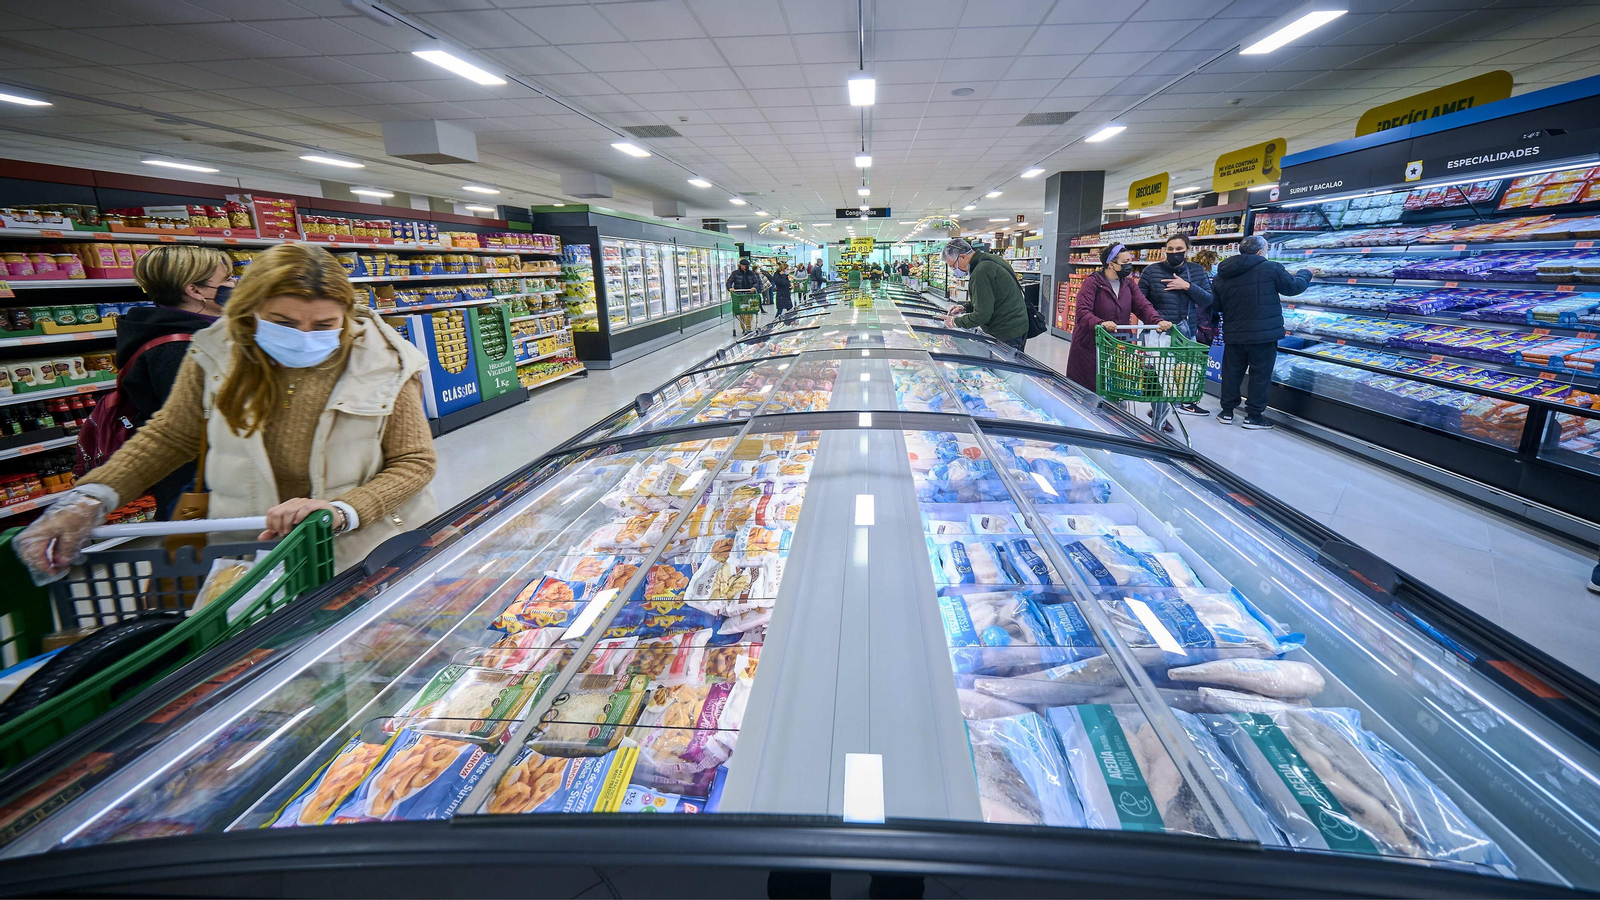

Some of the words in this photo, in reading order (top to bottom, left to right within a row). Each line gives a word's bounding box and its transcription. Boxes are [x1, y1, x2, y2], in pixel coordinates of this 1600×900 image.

[1235, 157, 1259, 168] CONTINÚA
[1447, 146, 1540, 169] ESPECIALIDADES
[1232, 164, 1256, 174] AMARILLO
[1289, 186, 1308, 195] SURIMI
[1313, 180, 1343, 191] BACALAO
[442, 382, 477, 403] CLÁSSICA
[5, 494, 29, 505] PESTO
[1100, 751, 1124, 780] ACEDÍA
[1115, 751, 1138, 780] LÍNGUA
[468, 774, 480, 784] de
[573, 780, 583, 790] de
[588, 773, 597, 783] de
[444, 784, 473, 817] Surimi
[563, 790, 580, 813] Suri
[575, 783, 594, 813] Surim
